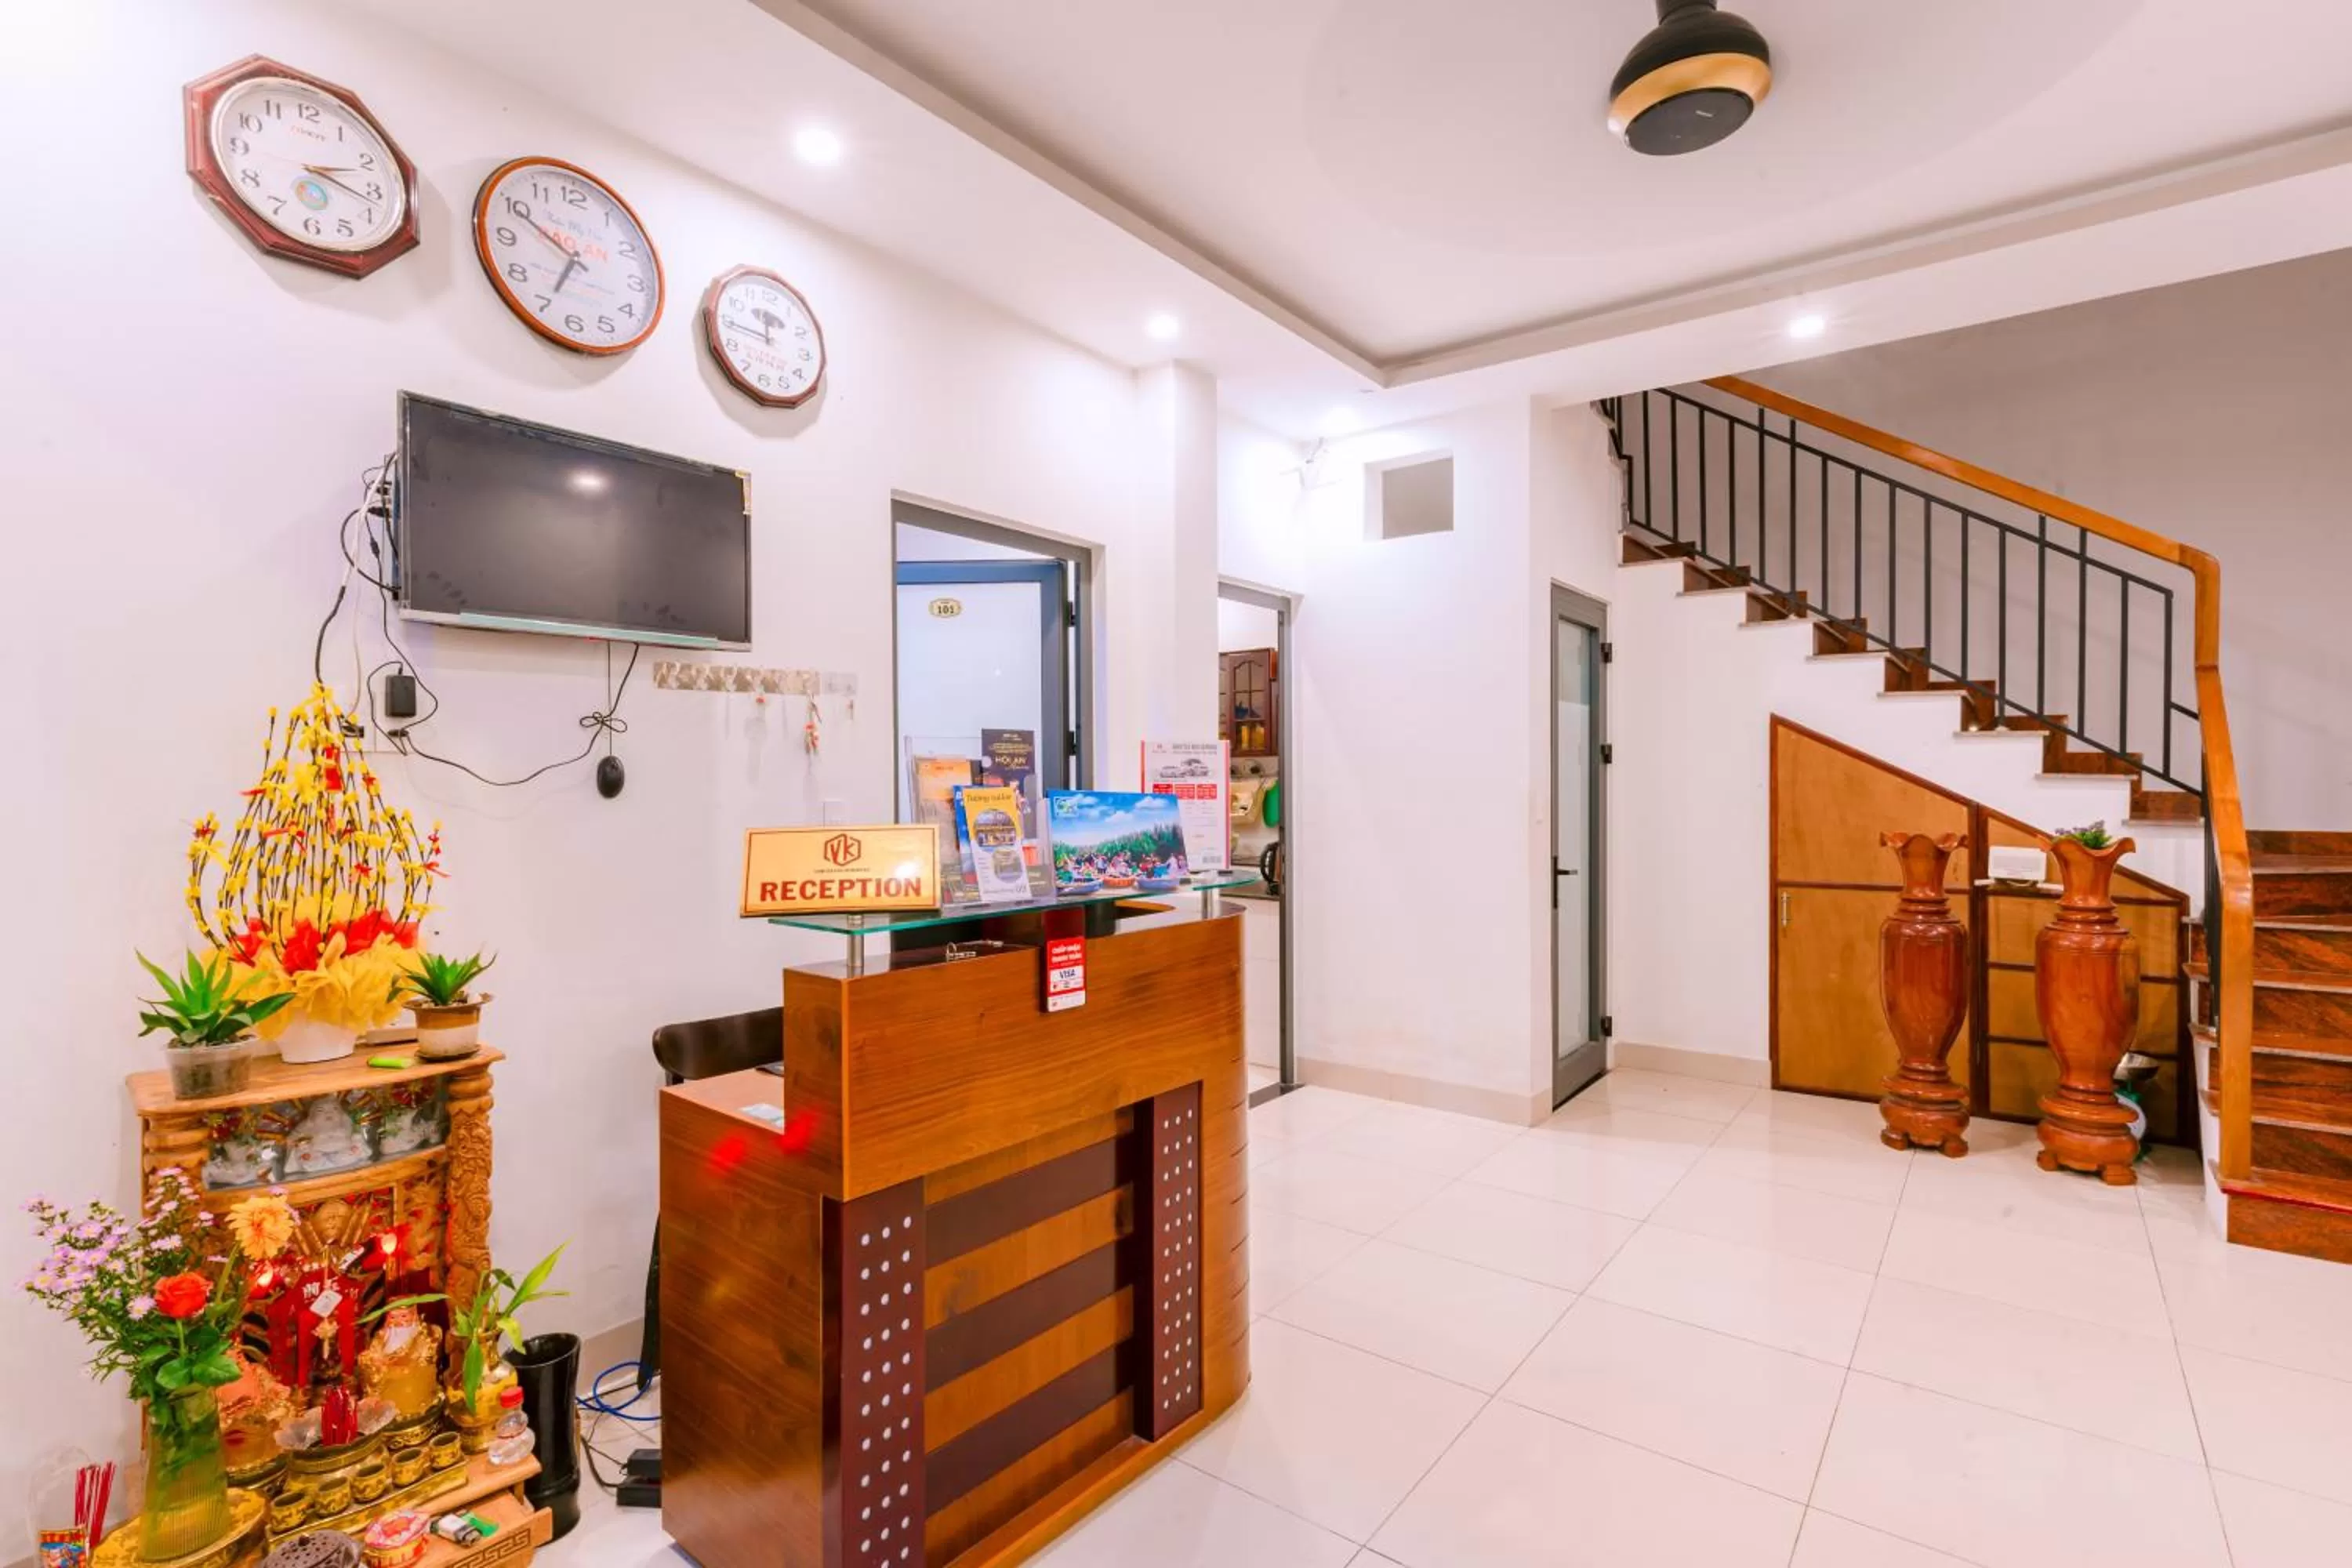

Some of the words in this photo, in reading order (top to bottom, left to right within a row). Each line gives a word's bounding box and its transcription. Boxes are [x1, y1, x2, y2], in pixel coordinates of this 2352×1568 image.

[264, 100, 281, 119] 11
[298, 103, 320, 123] 12
[238, 113, 263, 132] 10
[338, 125, 343, 142] 1
[230, 137, 249, 155] 9
[359, 153, 374, 171] 2
[241, 168, 260, 187] 8
[366, 182, 383, 201] 3
[532, 183, 549, 204] 11
[561, 186, 589, 210] 12
[267, 195, 286, 216] 7
[506, 197, 531, 218] 10
[358, 207, 372, 224] 4
[604, 212, 609, 227] 1
[303, 217, 321, 235] 6
[336, 219, 353, 237] 5
[496, 227, 517, 246] 9
[618, 241, 637, 260] 2
[508, 263, 527, 282] 8
[627, 275, 644, 292] 3
[746, 287, 754, 300] 11
[762, 289, 778, 304] 12
[534, 295, 552, 312] 7
[618, 303, 634, 318] 4
[729, 296, 744, 312] 10
[564, 314, 584, 332] 6
[597, 315, 615, 333] 5
[721, 314, 735, 328] 9
[794, 325, 807, 339] 2
[726, 338, 739, 351] 8
[799, 348, 810, 361] 3
[740, 359, 751, 372] 7
[793, 368, 805, 380] 4
[757, 374, 771, 387] 6
[778, 376, 790, 389] 5
[760, 877, 922, 902] RECEPTION
[1059, 969, 1076, 978] VISA
